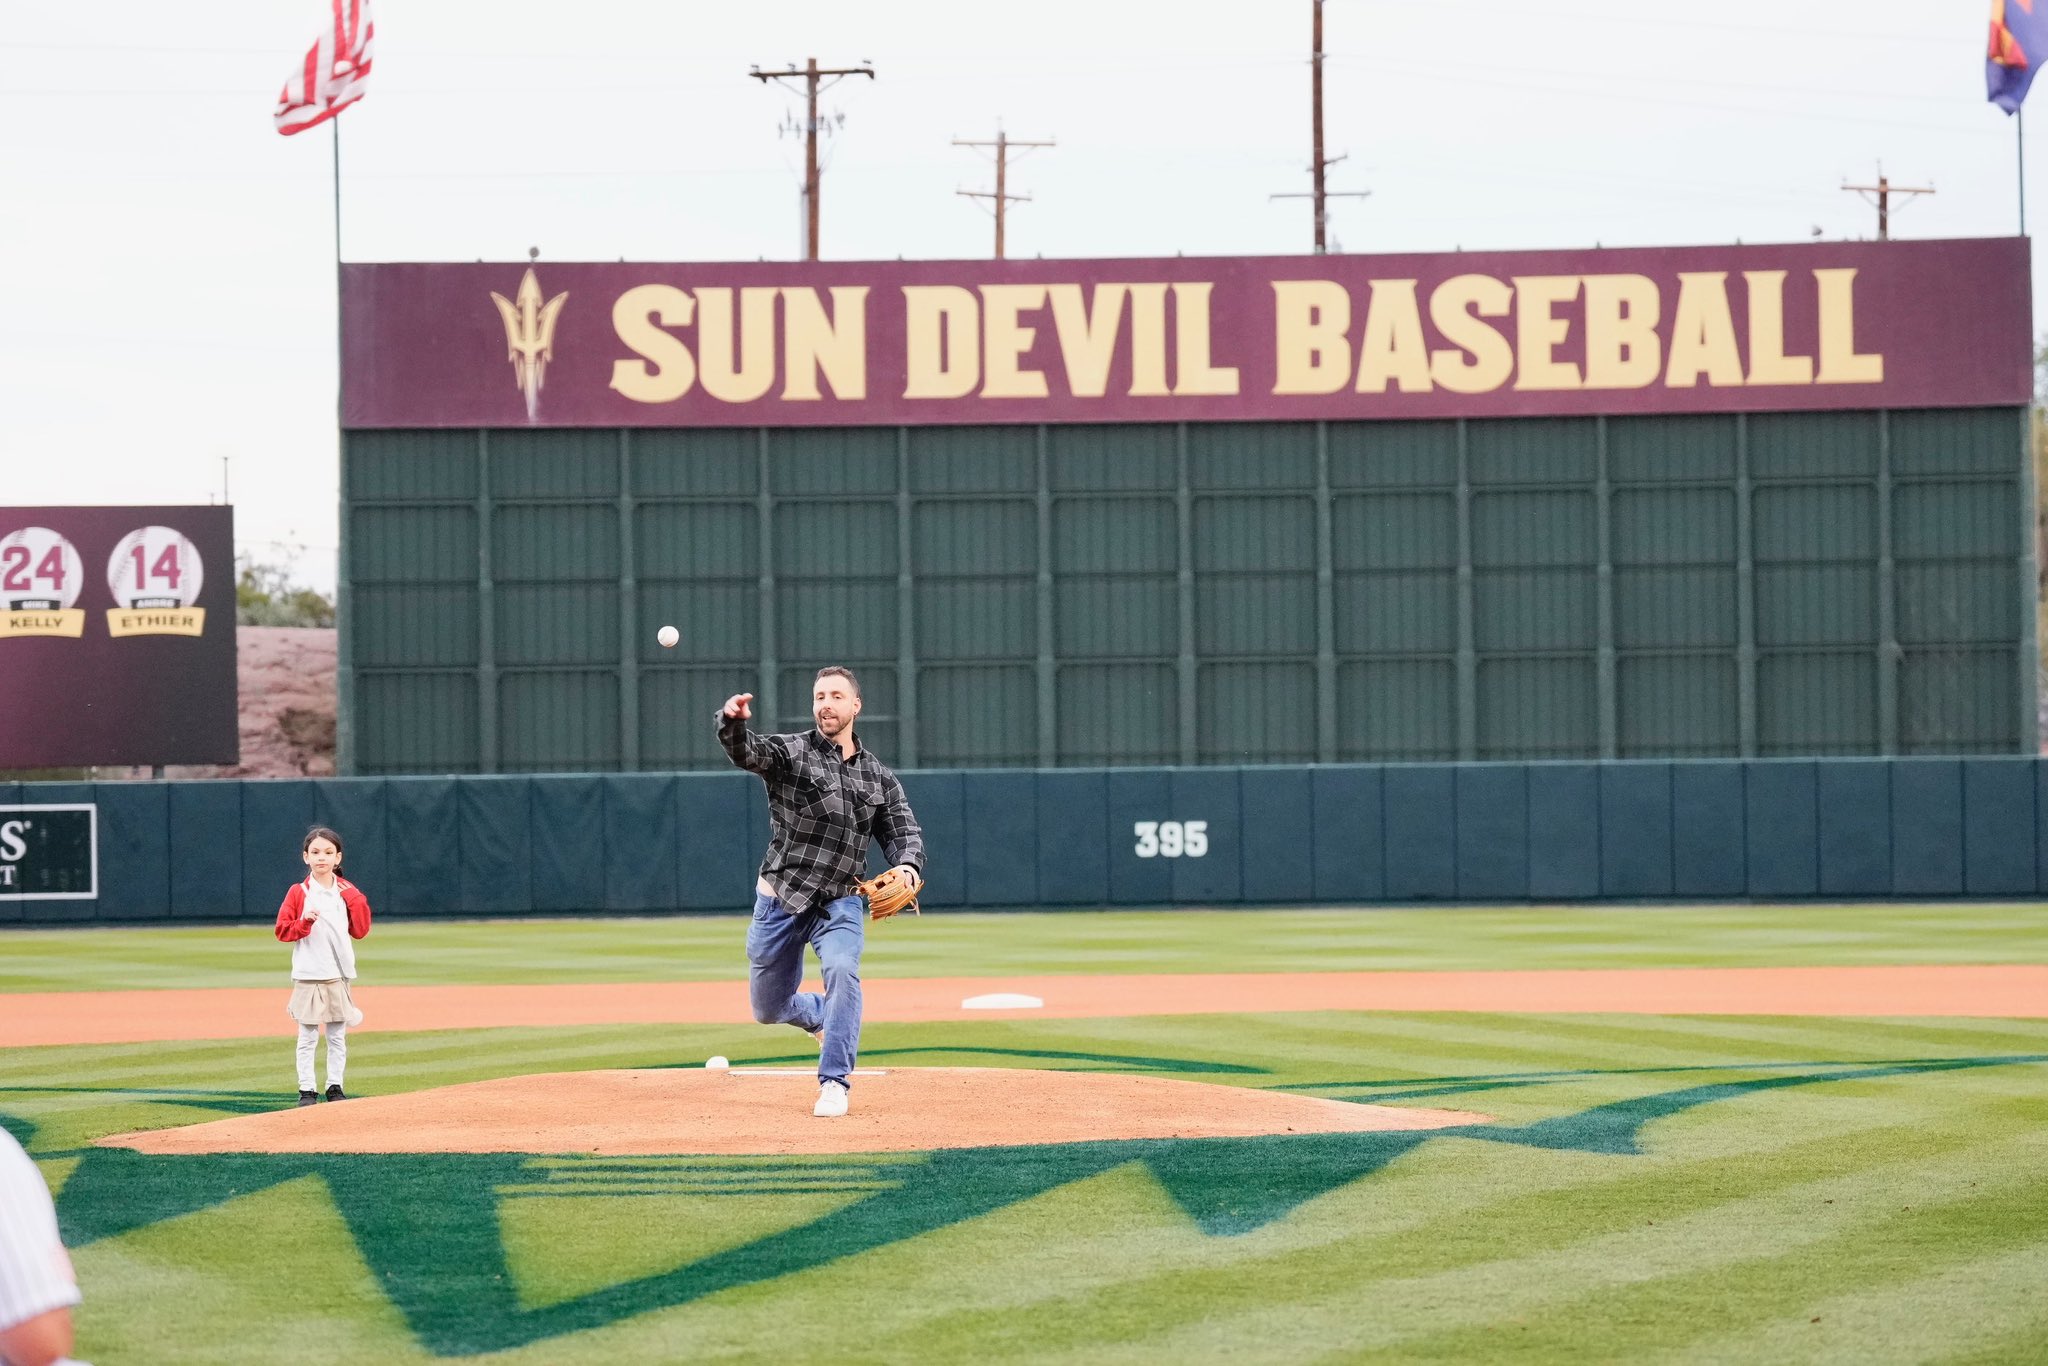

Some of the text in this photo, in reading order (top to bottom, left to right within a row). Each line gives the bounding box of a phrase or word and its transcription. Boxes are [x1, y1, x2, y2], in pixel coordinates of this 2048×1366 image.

[608, 267, 1884, 403] SUN DEVIL BASEBALL
[2, 546, 66, 591] 24
[130, 544, 182, 590] 14
[10, 616, 64, 630] KELLY
[121, 615, 195, 629] ETHIER
[1134, 820, 1209, 858] 395
